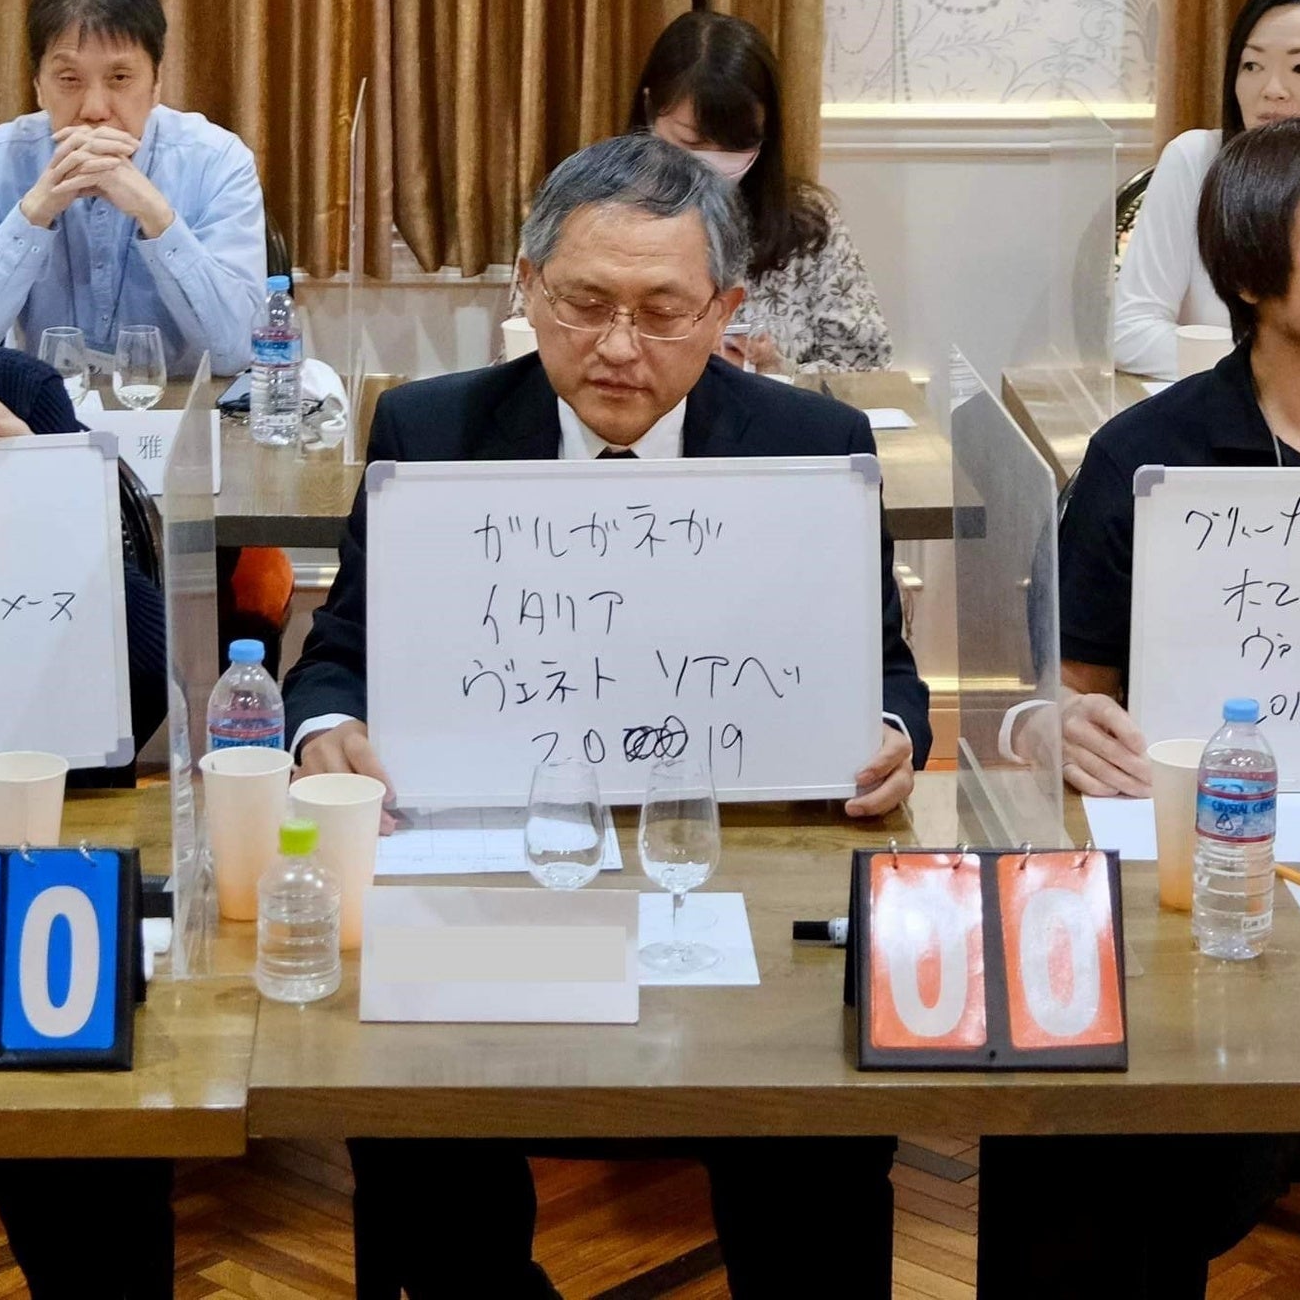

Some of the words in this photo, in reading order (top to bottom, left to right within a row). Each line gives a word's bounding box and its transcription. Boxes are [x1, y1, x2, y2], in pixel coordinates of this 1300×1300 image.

[137, 434, 163, 460] 雅
[483, 584, 624, 645] イタリア
[888, 886, 1102, 1038] 00
